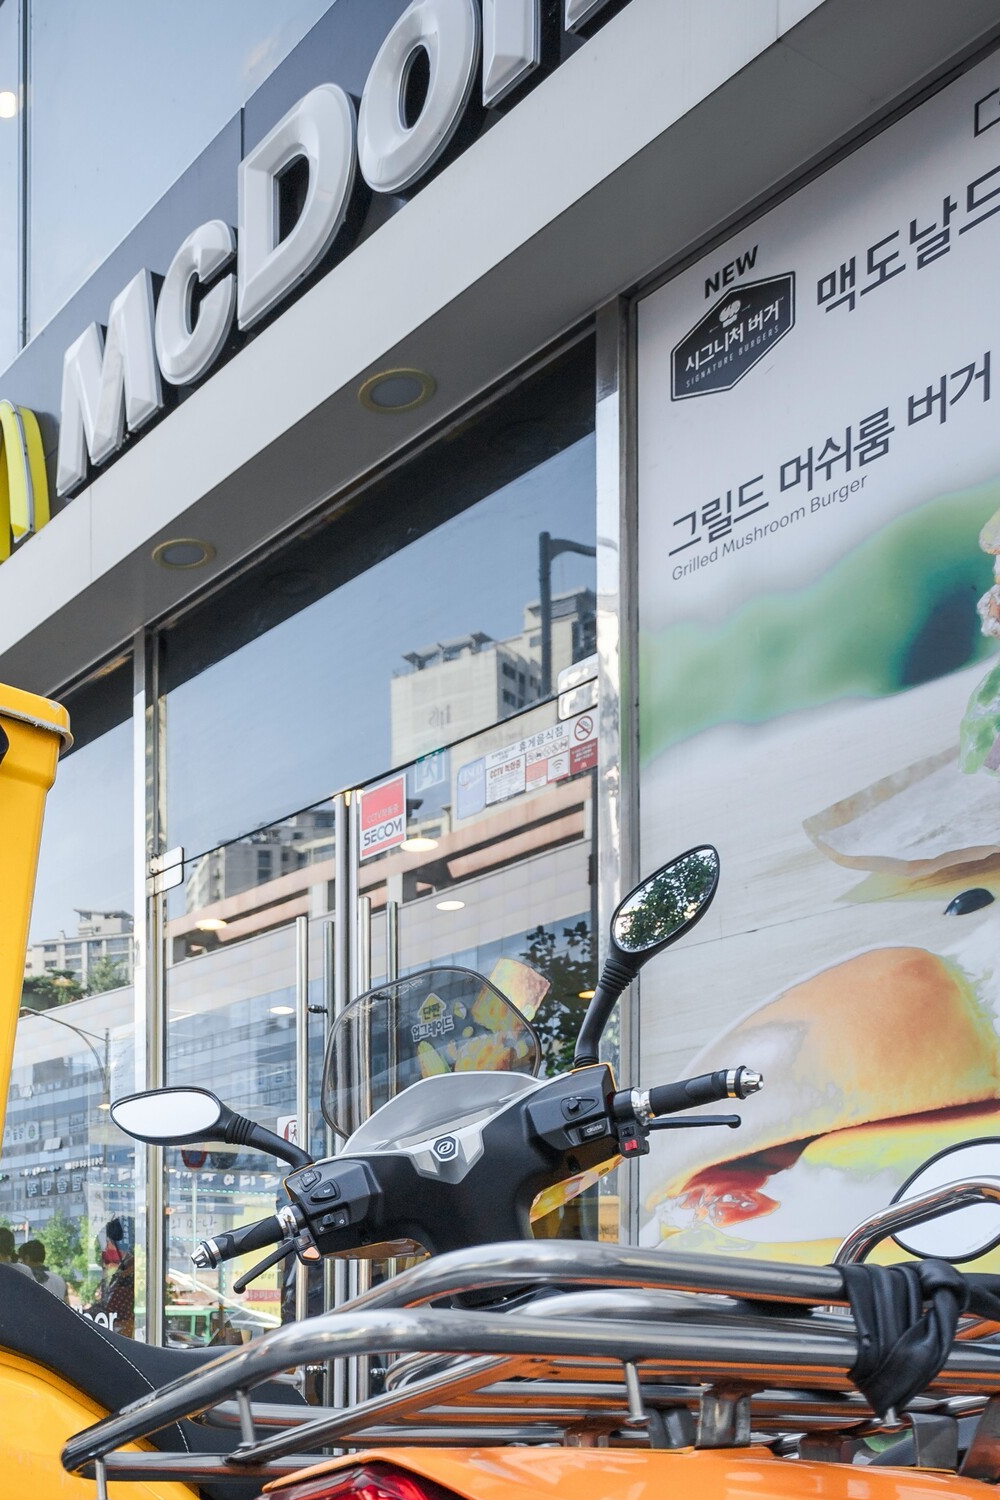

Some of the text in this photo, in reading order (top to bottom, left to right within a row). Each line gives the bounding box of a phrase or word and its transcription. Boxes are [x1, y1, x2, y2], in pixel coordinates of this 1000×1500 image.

[704, 244, 759, 299] NEW
[685, 300, 780, 372] 시그니처 버거
[685, 324, 780, 388] SIGNATURE BURGERS
[669, 350, 991, 557] 그릴드 머쉬룸 버거
[672, 475, 868, 581] Grilled Mushroom Burger
[363, 817, 403, 847] SECOM
[412, 1016, 454, 1041] 업그레이드
